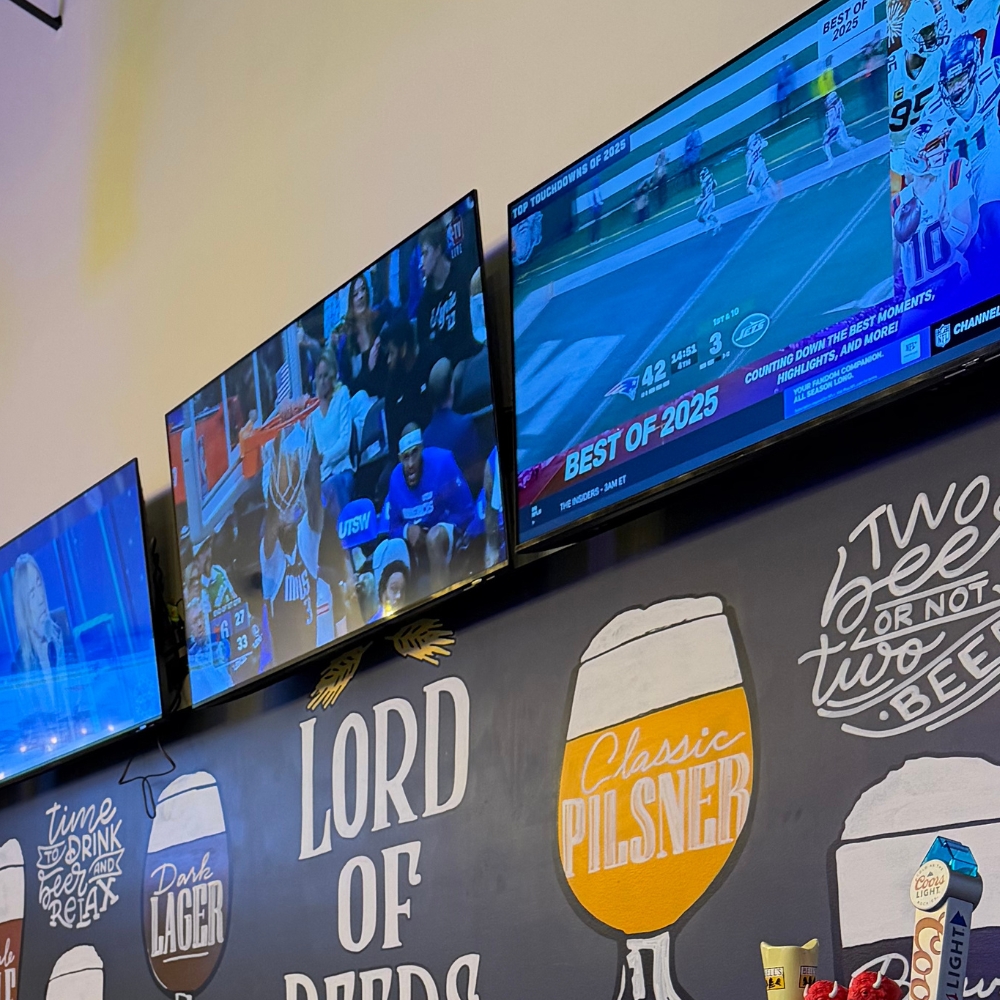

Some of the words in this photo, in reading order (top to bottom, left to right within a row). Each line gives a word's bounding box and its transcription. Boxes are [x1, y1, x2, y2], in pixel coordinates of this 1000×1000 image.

[823, 8, 851, 34] BEST
[853, 0, 868, 14] OF
[832, 16, 859, 41] 2025
[512, 203, 528, 219] TOP
[529, 165, 588, 208] TOUCHDOWNS
[590, 154, 601, 170] OF
[603, 138, 626, 161] 2025
[905, 220, 950, 287] 10
[731, 307, 740, 316] 10
[735, 319, 765, 341] JETS
[670, 344, 697, 364] 14:51
[709, 332, 722, 354] 3
[745, 355, 794, 385] COUNTING
[795, 339, 827, 363] DOWN
[827, 330, 847, 350] THE
[850, 318, 876, 339] BEST
[877, 289, 935, 328] MOMENTS,
[777, 348, 838, 385] HIGHLIGHTS,
[840, 336, 863, 356] AND
[864, 321, 899, 349] MORE!
[642, 360, 666, 386] 42
[677, 359, 691, 370] 4TH
[793, 382, 811, 395] YOUR
[794, 393, 806, 404] ALL
[807, 381, 833, 398] SEASON
[564, 429, 622, 482] BEST
[625, 414, 658, 452] OF
[659, 385, 719, 438] 2025
[560, 500, 571, 512] THE
[572, 486, 600, 509] INSIDERS
[618, 475, 627, 489] ET
[338, 511, 371, 539] UTSW
[849, 475, 990, 570] TWO
[820, 526, 1000, 634] bee
[234, 609, 245, 626] 27
[874, 603, 913, 635] OR
[925, 579, 989, 621] NOT
[236, 634, 248, 651] 33
[798, 632, 946, 707] two
[298, 676, 471, 860] LORD
[581, 727, 746, 795] Classic
[45, 797, 116, 845] time
[562, 752, 751, 879] PILSNER
[43, 849, 59, 863] TO
[64, 819, 122, 865] DRINK
[37, 861, 89, 911] beer
[93, 857, 115, 876] AND
[151, 852, 213, 895] Dark
[337, 841, 422, 952] OF
[915, 874, 945, 890] Coors
[916, 886, 941, 898] LIGHT
[150, 880, 224, 958] LAGER
[946, 926, 965, 989] LIGHT
